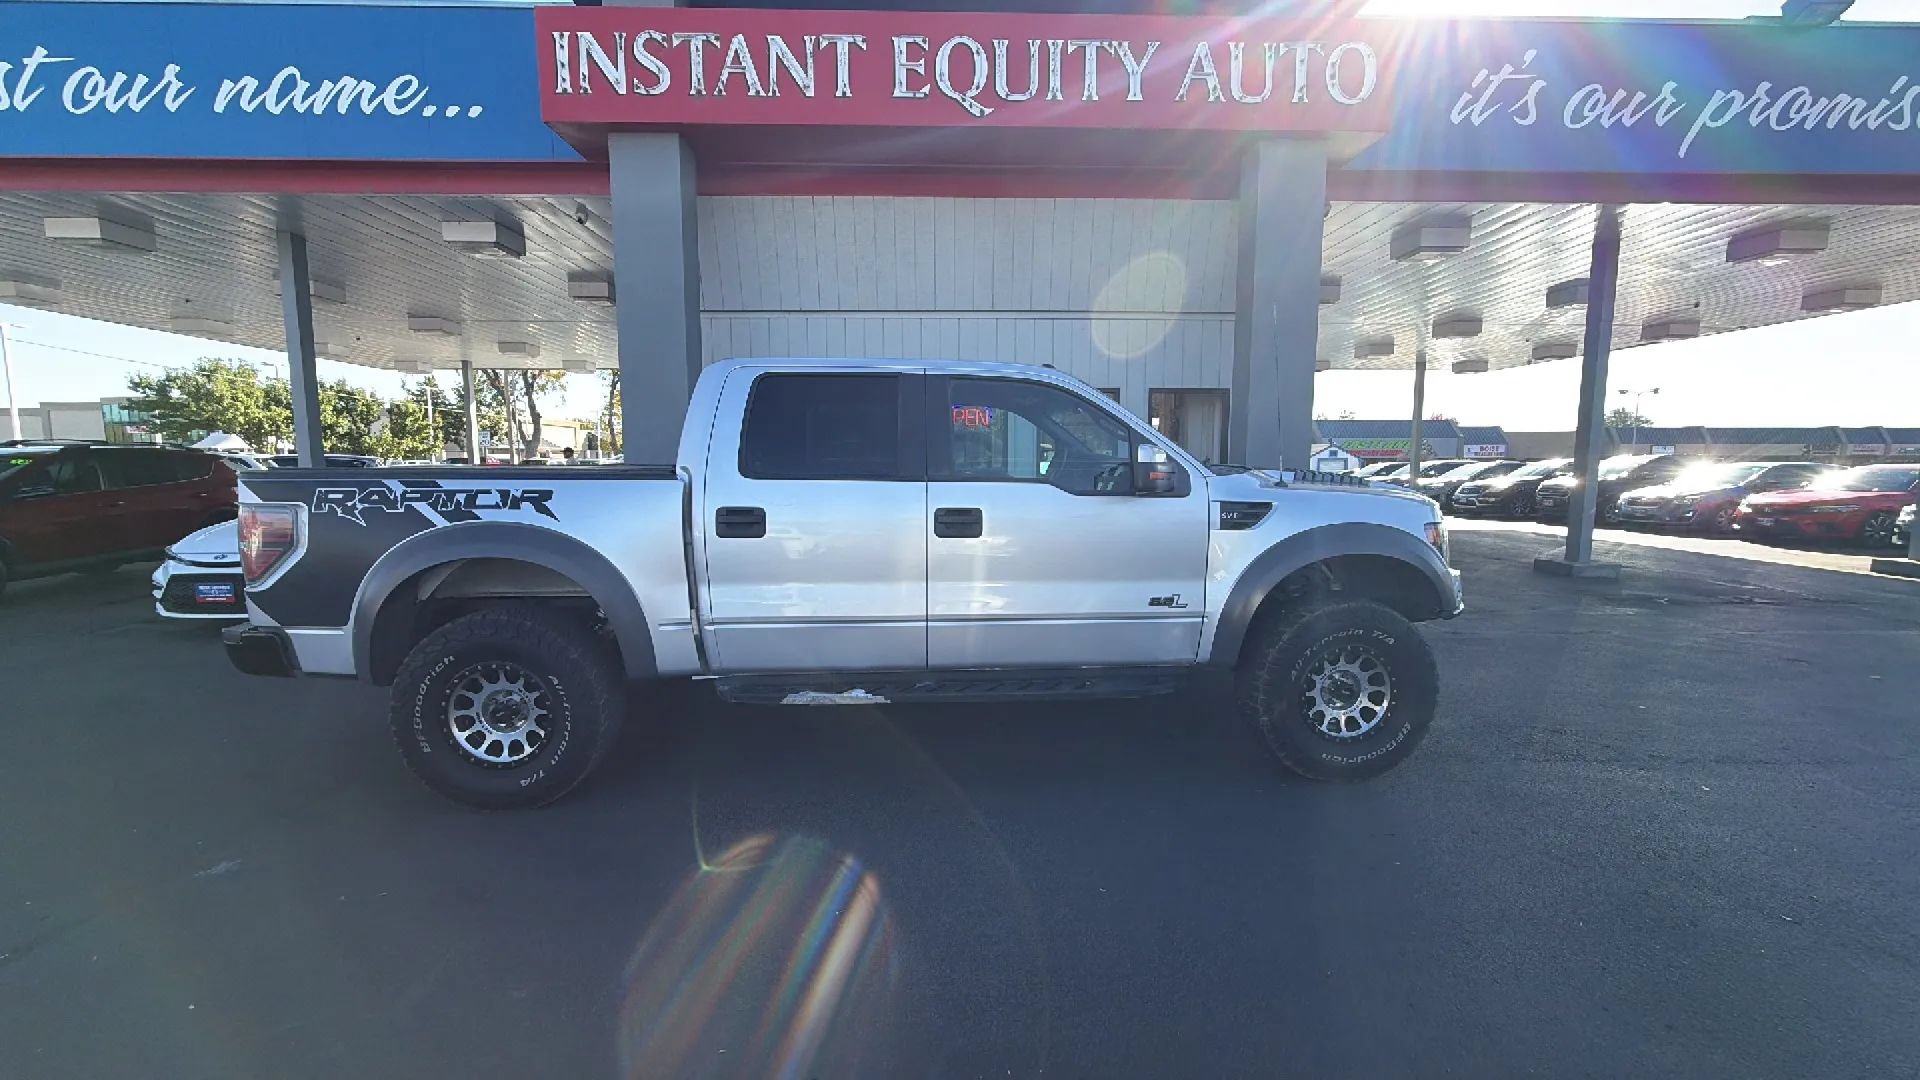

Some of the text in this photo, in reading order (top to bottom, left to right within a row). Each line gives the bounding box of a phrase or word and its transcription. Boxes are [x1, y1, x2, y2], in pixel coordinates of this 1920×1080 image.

[62, 63, 195, 115] our
[213, 65, 484, 118] name...
[552, 30, 1378, 117] INSTANT EQUITY AUTO
[1449, 49, 1920, 159] it's our promis
[312, 487, 560, 527] RAPTOR
